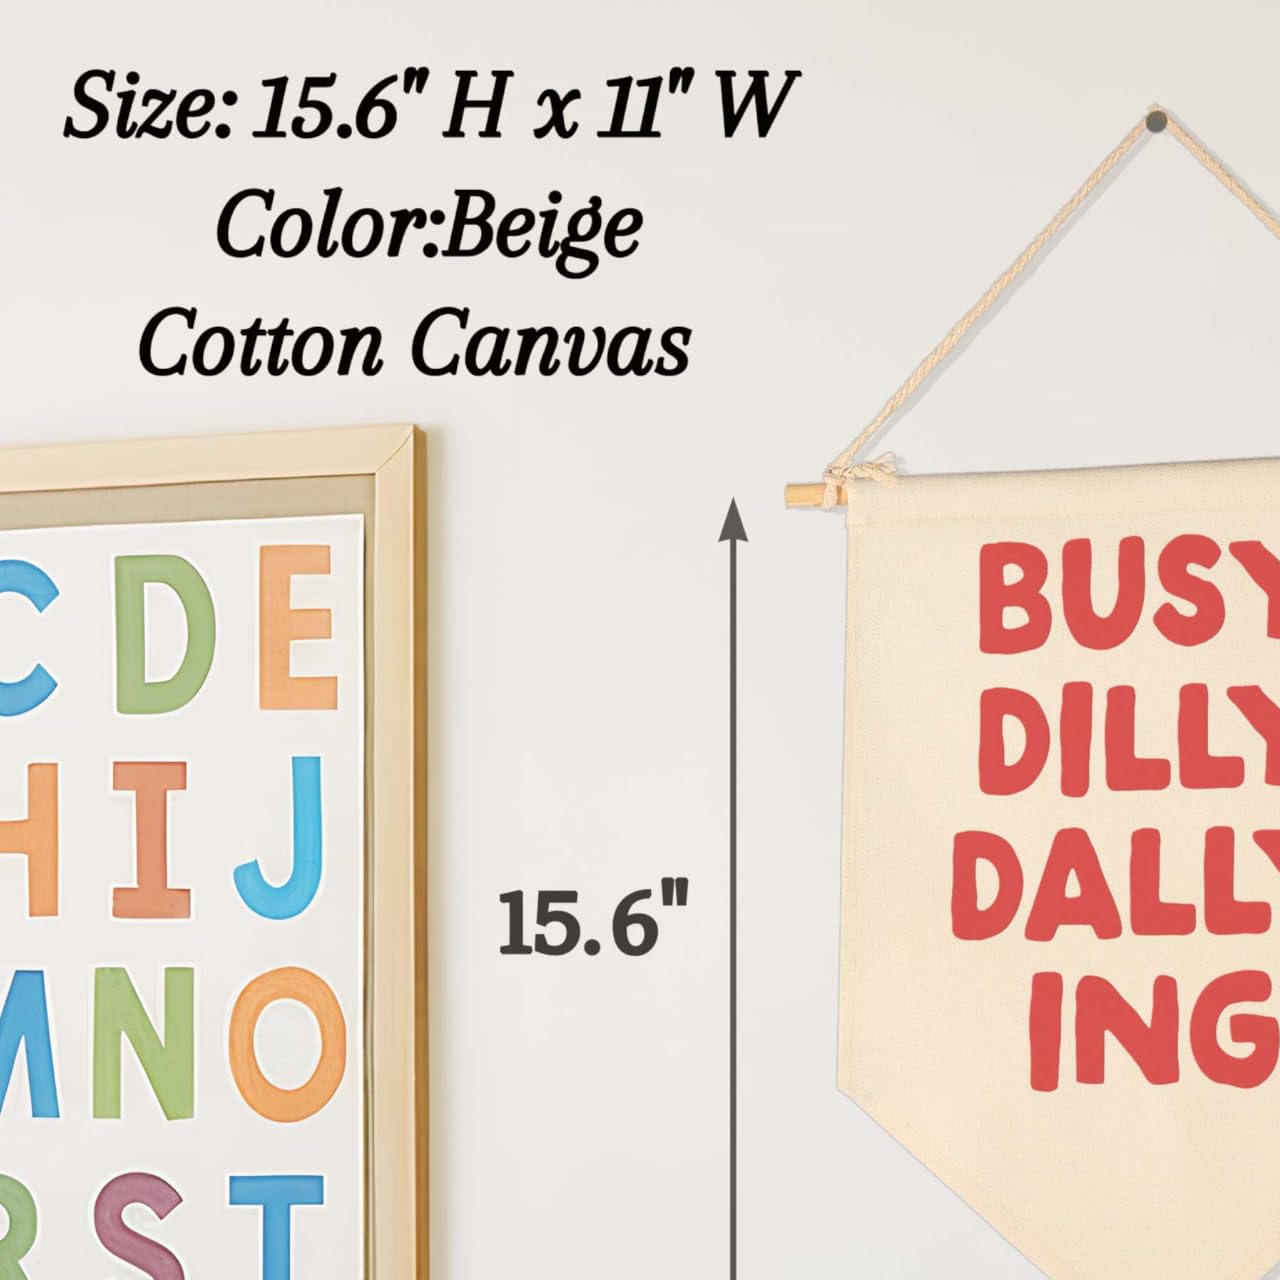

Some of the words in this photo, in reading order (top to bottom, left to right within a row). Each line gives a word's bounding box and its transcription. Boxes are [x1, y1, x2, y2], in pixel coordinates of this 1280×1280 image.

[115, 555, 216, 714] D
[259, 544, 338, 711] E
[112, 761, 191, 919] I
[233, 756, 323, 920] J
[93, 967, 194, 1120] N
[228, 966, 347, 1123] O
[1029, 970, 1280, 1092] ING
